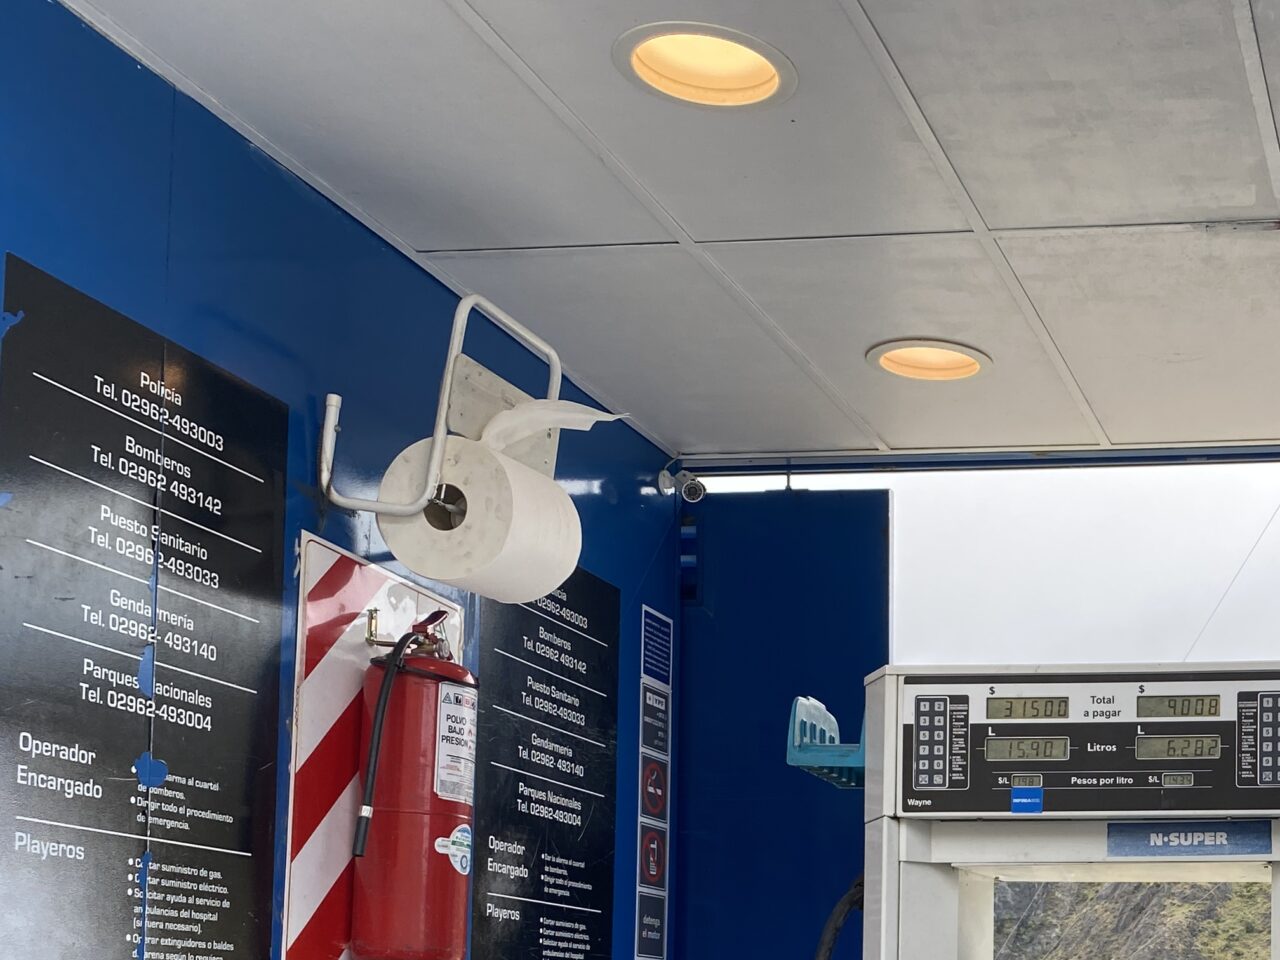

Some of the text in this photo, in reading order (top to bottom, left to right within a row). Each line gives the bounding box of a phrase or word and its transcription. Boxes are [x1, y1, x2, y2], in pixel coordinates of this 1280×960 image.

[140, 371, 182, 406] Policía
[94, 375, 224, 451] Tel. 02962-493003
[125, 435, 191, 478] Bomberos
[91, 445, 115, 472] Tel.
[170, 483, 222, 516] 493142
[100, 505, 208, 561] Puesto Sanitario
[88, 527, 220, 590] Tel. 02962-493033
[110, 590, 194, 630] Gendamería
[81, 604, 105, 627] Tel.
[164, 634, 217, 662] 493140
[539, 626, 571, 651] Bomberos
[560, 655, 587, 674] 493142
[83, 658, 212, 708] Parques acionales
[527, 675, 579, 707] Puesto Sanitario
[989, 686, 995, 695] $
[1139, 684, 1145, 694] $
[79, 683, 212, 732] Tel. 02962-493004
[1004, 700, 1068, 717] 31500
[1090, 695, 1115, 706] Total
[1168, 699, 1218, 716] 9008
[447, 714, 466, 725] POLVO
[535, 699, 585, 726] 02962-493033
[1083, 708, 1121, 720] a pagar
[448, 725, 464, 735] BAJO
[988, 726, 996, 736] L
[1137, 725, 1145, 735] L
[19, 732, 96, 765] Operador
[532, 733, 572, 757] Gendarmería
[1087, 742, 1117, 753] Litros
[557, 759, 584, 777] 493140
[17, 765, 102, 799] Encargado
[138, 783, 147, 792] de
[195, 778, 219, 791] cuartel
[1071, 776, 1134, 786] Pesos por litro
[519, 782, 581, 811] Parques Nacionales
[907, 798, 932, 807] Wayne
[137, 813, 146, 822] de
[161, 803, 177, 813] todo
[179, 805, 185, 814] el
[187, 807, 233, 823] procedimiento
[530, 803, 581, 827] 02962-493004
[15, 832, 85, 860] Playeros
[488, 835, 525, 856] Operador
[161, 863, 222, 880] suministro de gas.
[487, 858, 528, 878] Encargado
[161, 878, 197, 890] suministro
[166, 893, 187, 904] ayuda
[195, 897, 221, 907] servicio
[222, 899, 230, 908] de
[180, 907, 218, 922] del hospital
[486, 903, 520, 922] Playeros
[161, 937, 206, 949] extinguidores
[213, 940, 234, 951] baldes
